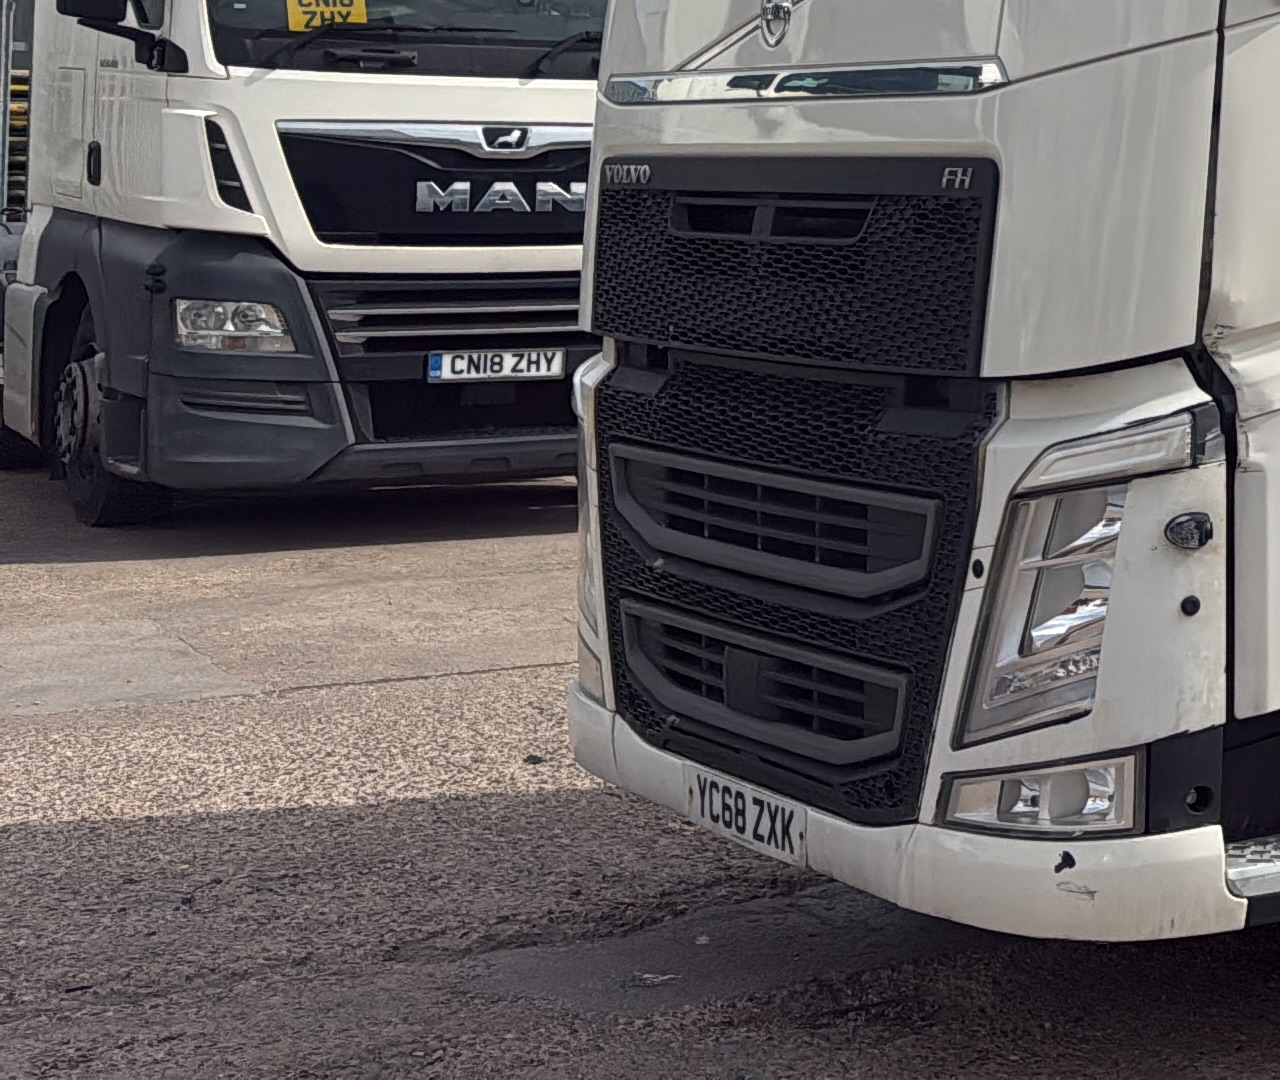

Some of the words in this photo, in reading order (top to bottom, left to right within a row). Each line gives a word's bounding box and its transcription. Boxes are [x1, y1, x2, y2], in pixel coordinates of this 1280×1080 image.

[302, 11, 352, 29] ZHY
[604, 164, 651, 184] VOLVO
[941, 167, 973, 189] FH
[415, 182, 587, 212] MAN
[450, 353, 504, 375] CN18
[510, 352, 556, 374] ZHY
[697, 773, 746, 835] YC68
[752, 796, 794, 855] ZXK
